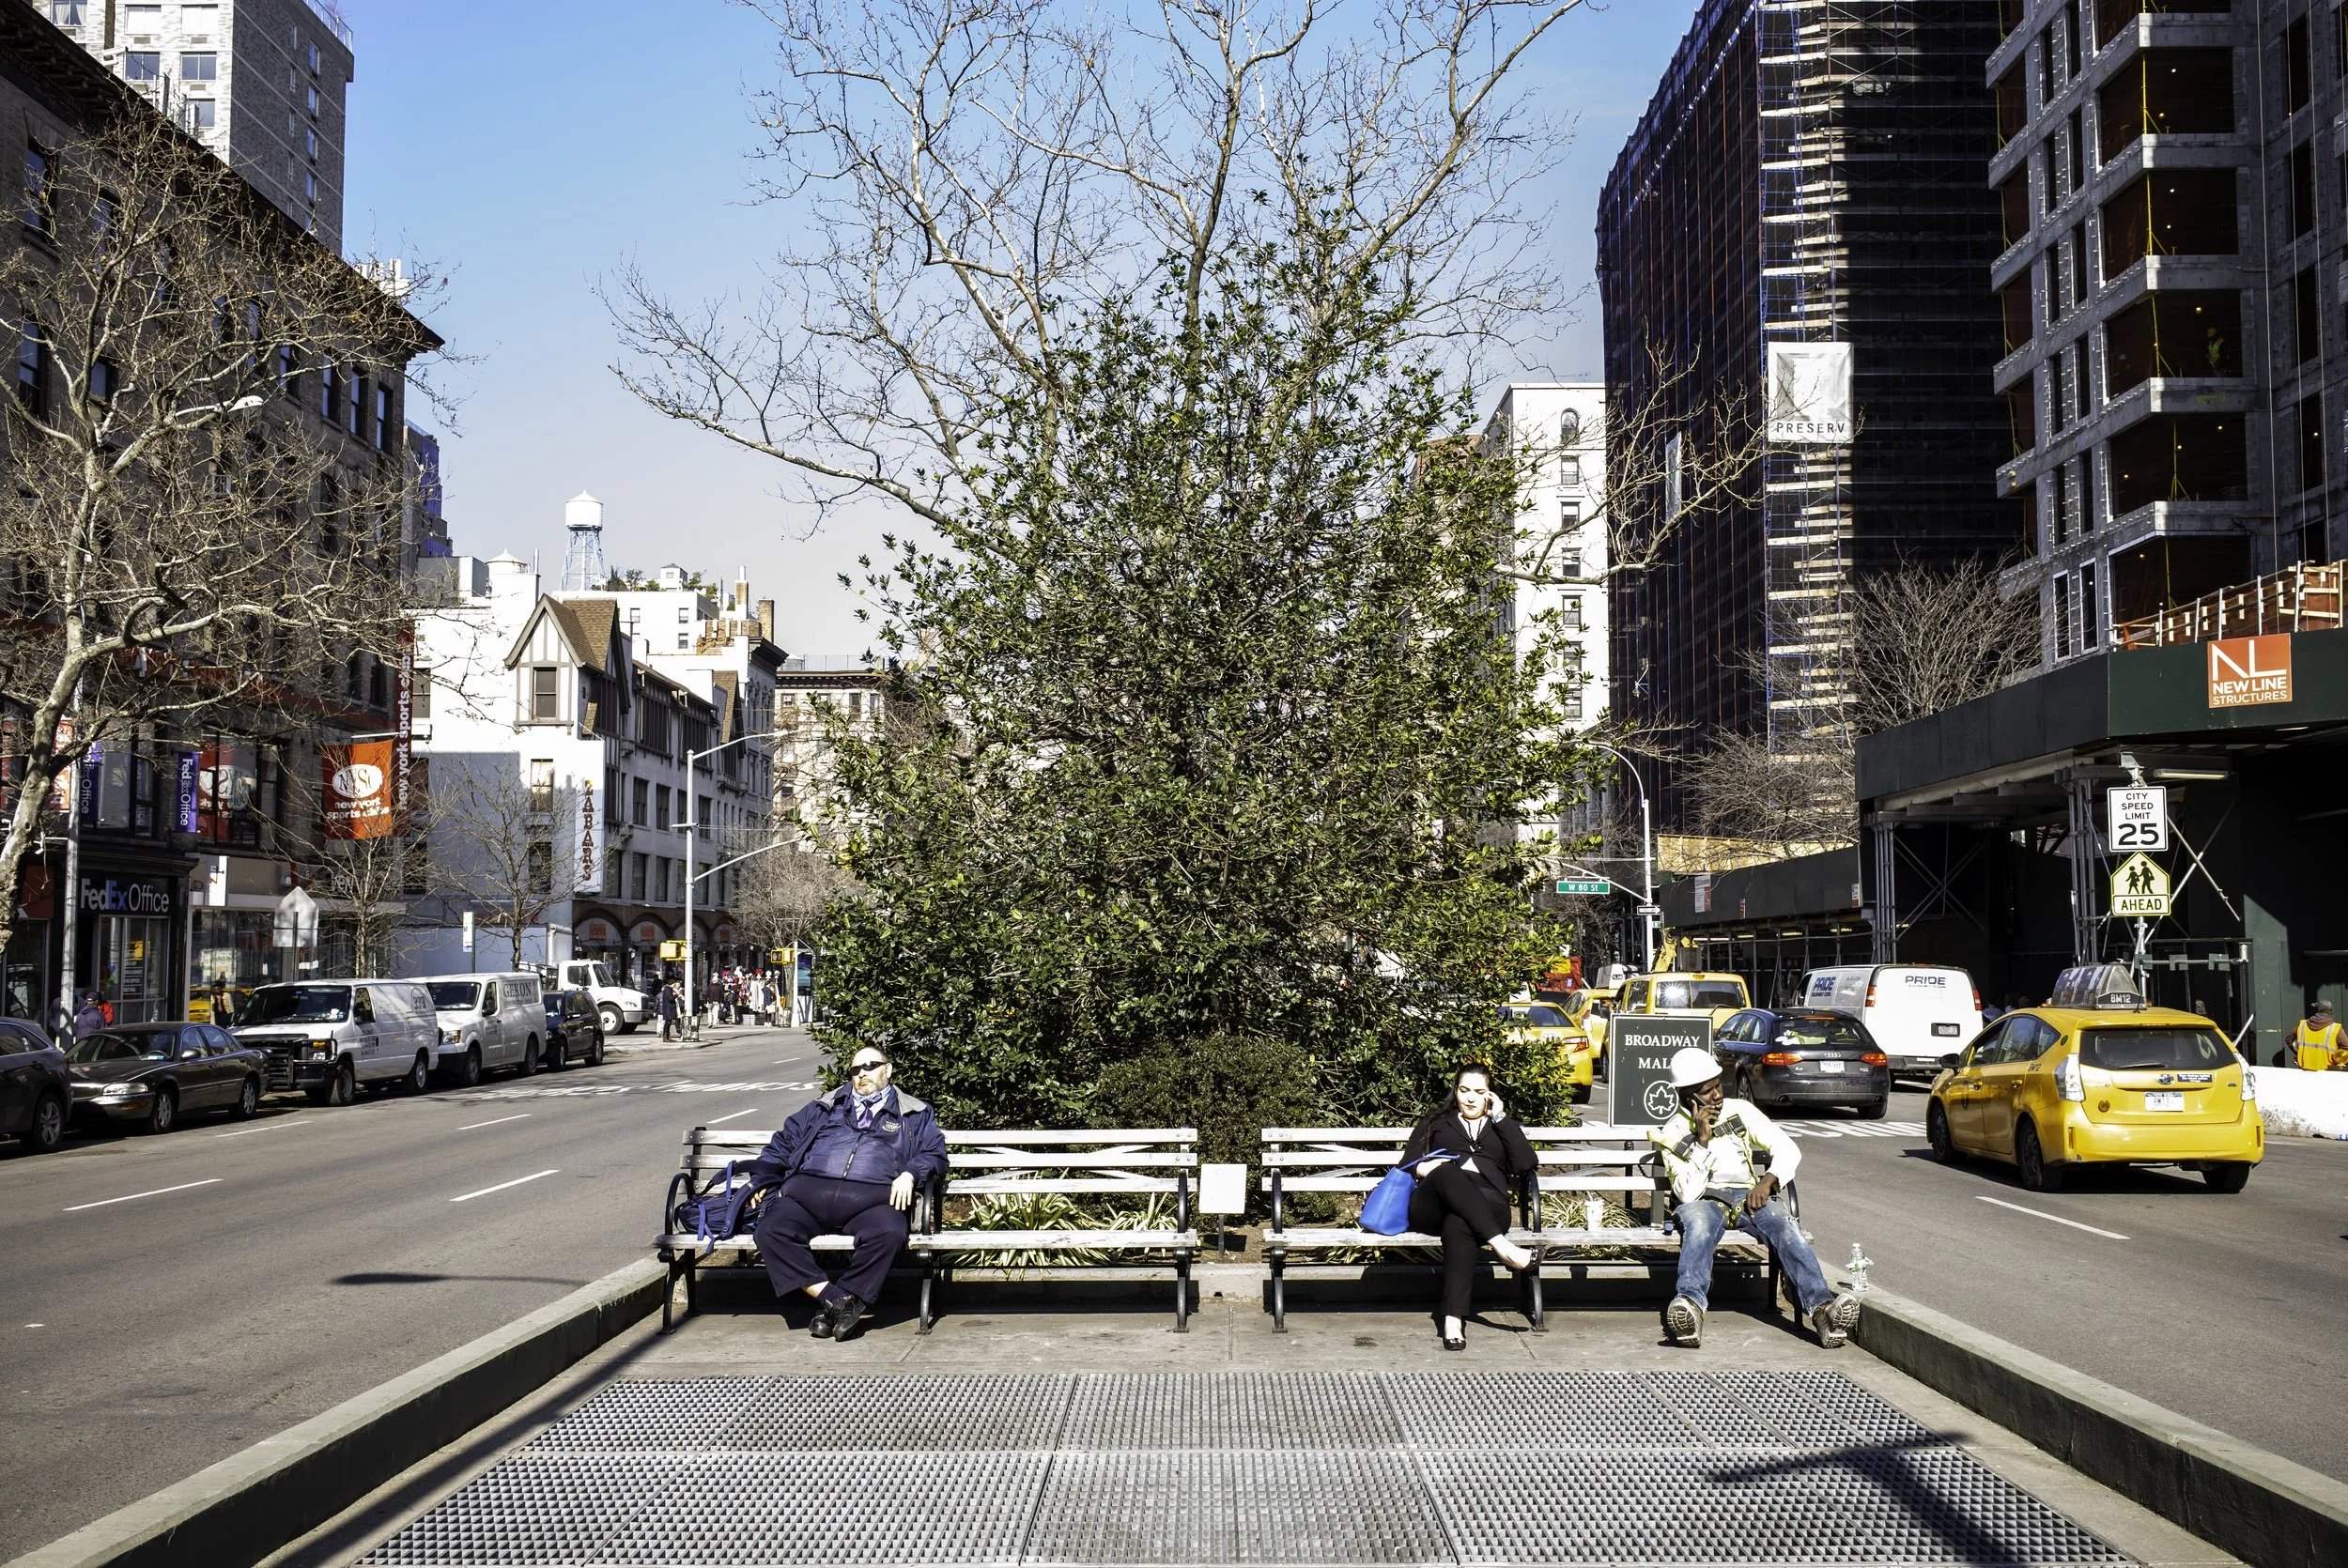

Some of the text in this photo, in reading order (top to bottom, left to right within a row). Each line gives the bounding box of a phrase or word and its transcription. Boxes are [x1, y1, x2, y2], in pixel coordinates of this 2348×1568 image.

[1776, 423, 1846, 433] PRESERV
[2211, 639, 2287, 682] NL
[2213, 676, 2287, 695] NEW LINE
[2213, 690, 2288, 705] STRUCTURES
[398, 691, 411, 739] sports
[397, 742, 410, 776] york
[81, 779, 92, 814] Office
[2125, 792, 2149, 801] CITY
[179, 793, 192, 826] Office
[2121, 802, 2154, 810] SPEED
[327, 809, 361, 820] sports
[2118, 822, 2159, 846] 25
[81, 878, 170, 913] FedEx Office
[2121, 898, 2162, 911] AHEAD
[1813, 976, 1837, 992] PRIDE
[1905, 976, 1946, 986] PRIDE
[1624, 1034, 1701, 1047] BROADWAY
[1638, 1057, 1673, 1069] MAL
